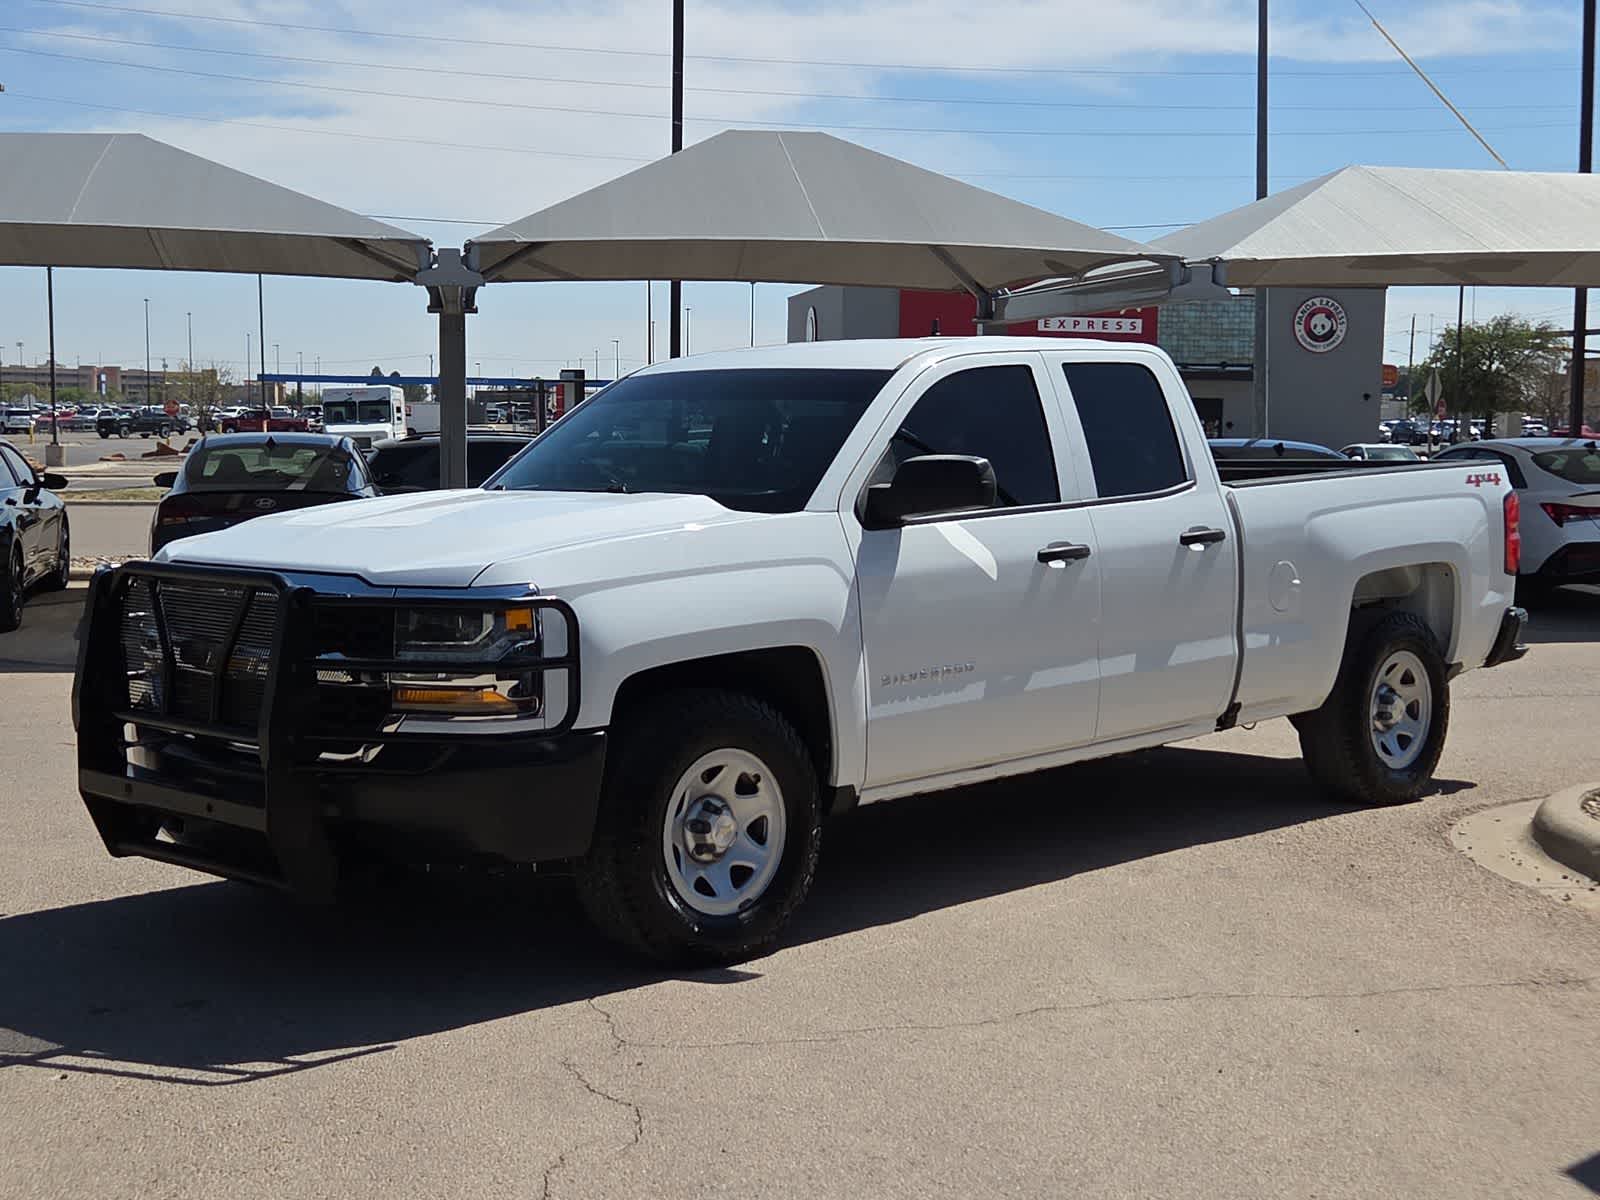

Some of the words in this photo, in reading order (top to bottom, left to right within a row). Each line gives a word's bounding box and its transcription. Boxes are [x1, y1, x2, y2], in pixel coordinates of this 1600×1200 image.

[1296, 300, 1317, 326] PANDA
[1319, 299, 1345, 326] EXPRESS
[1043, 319, 1138, 331] EXPRESS
